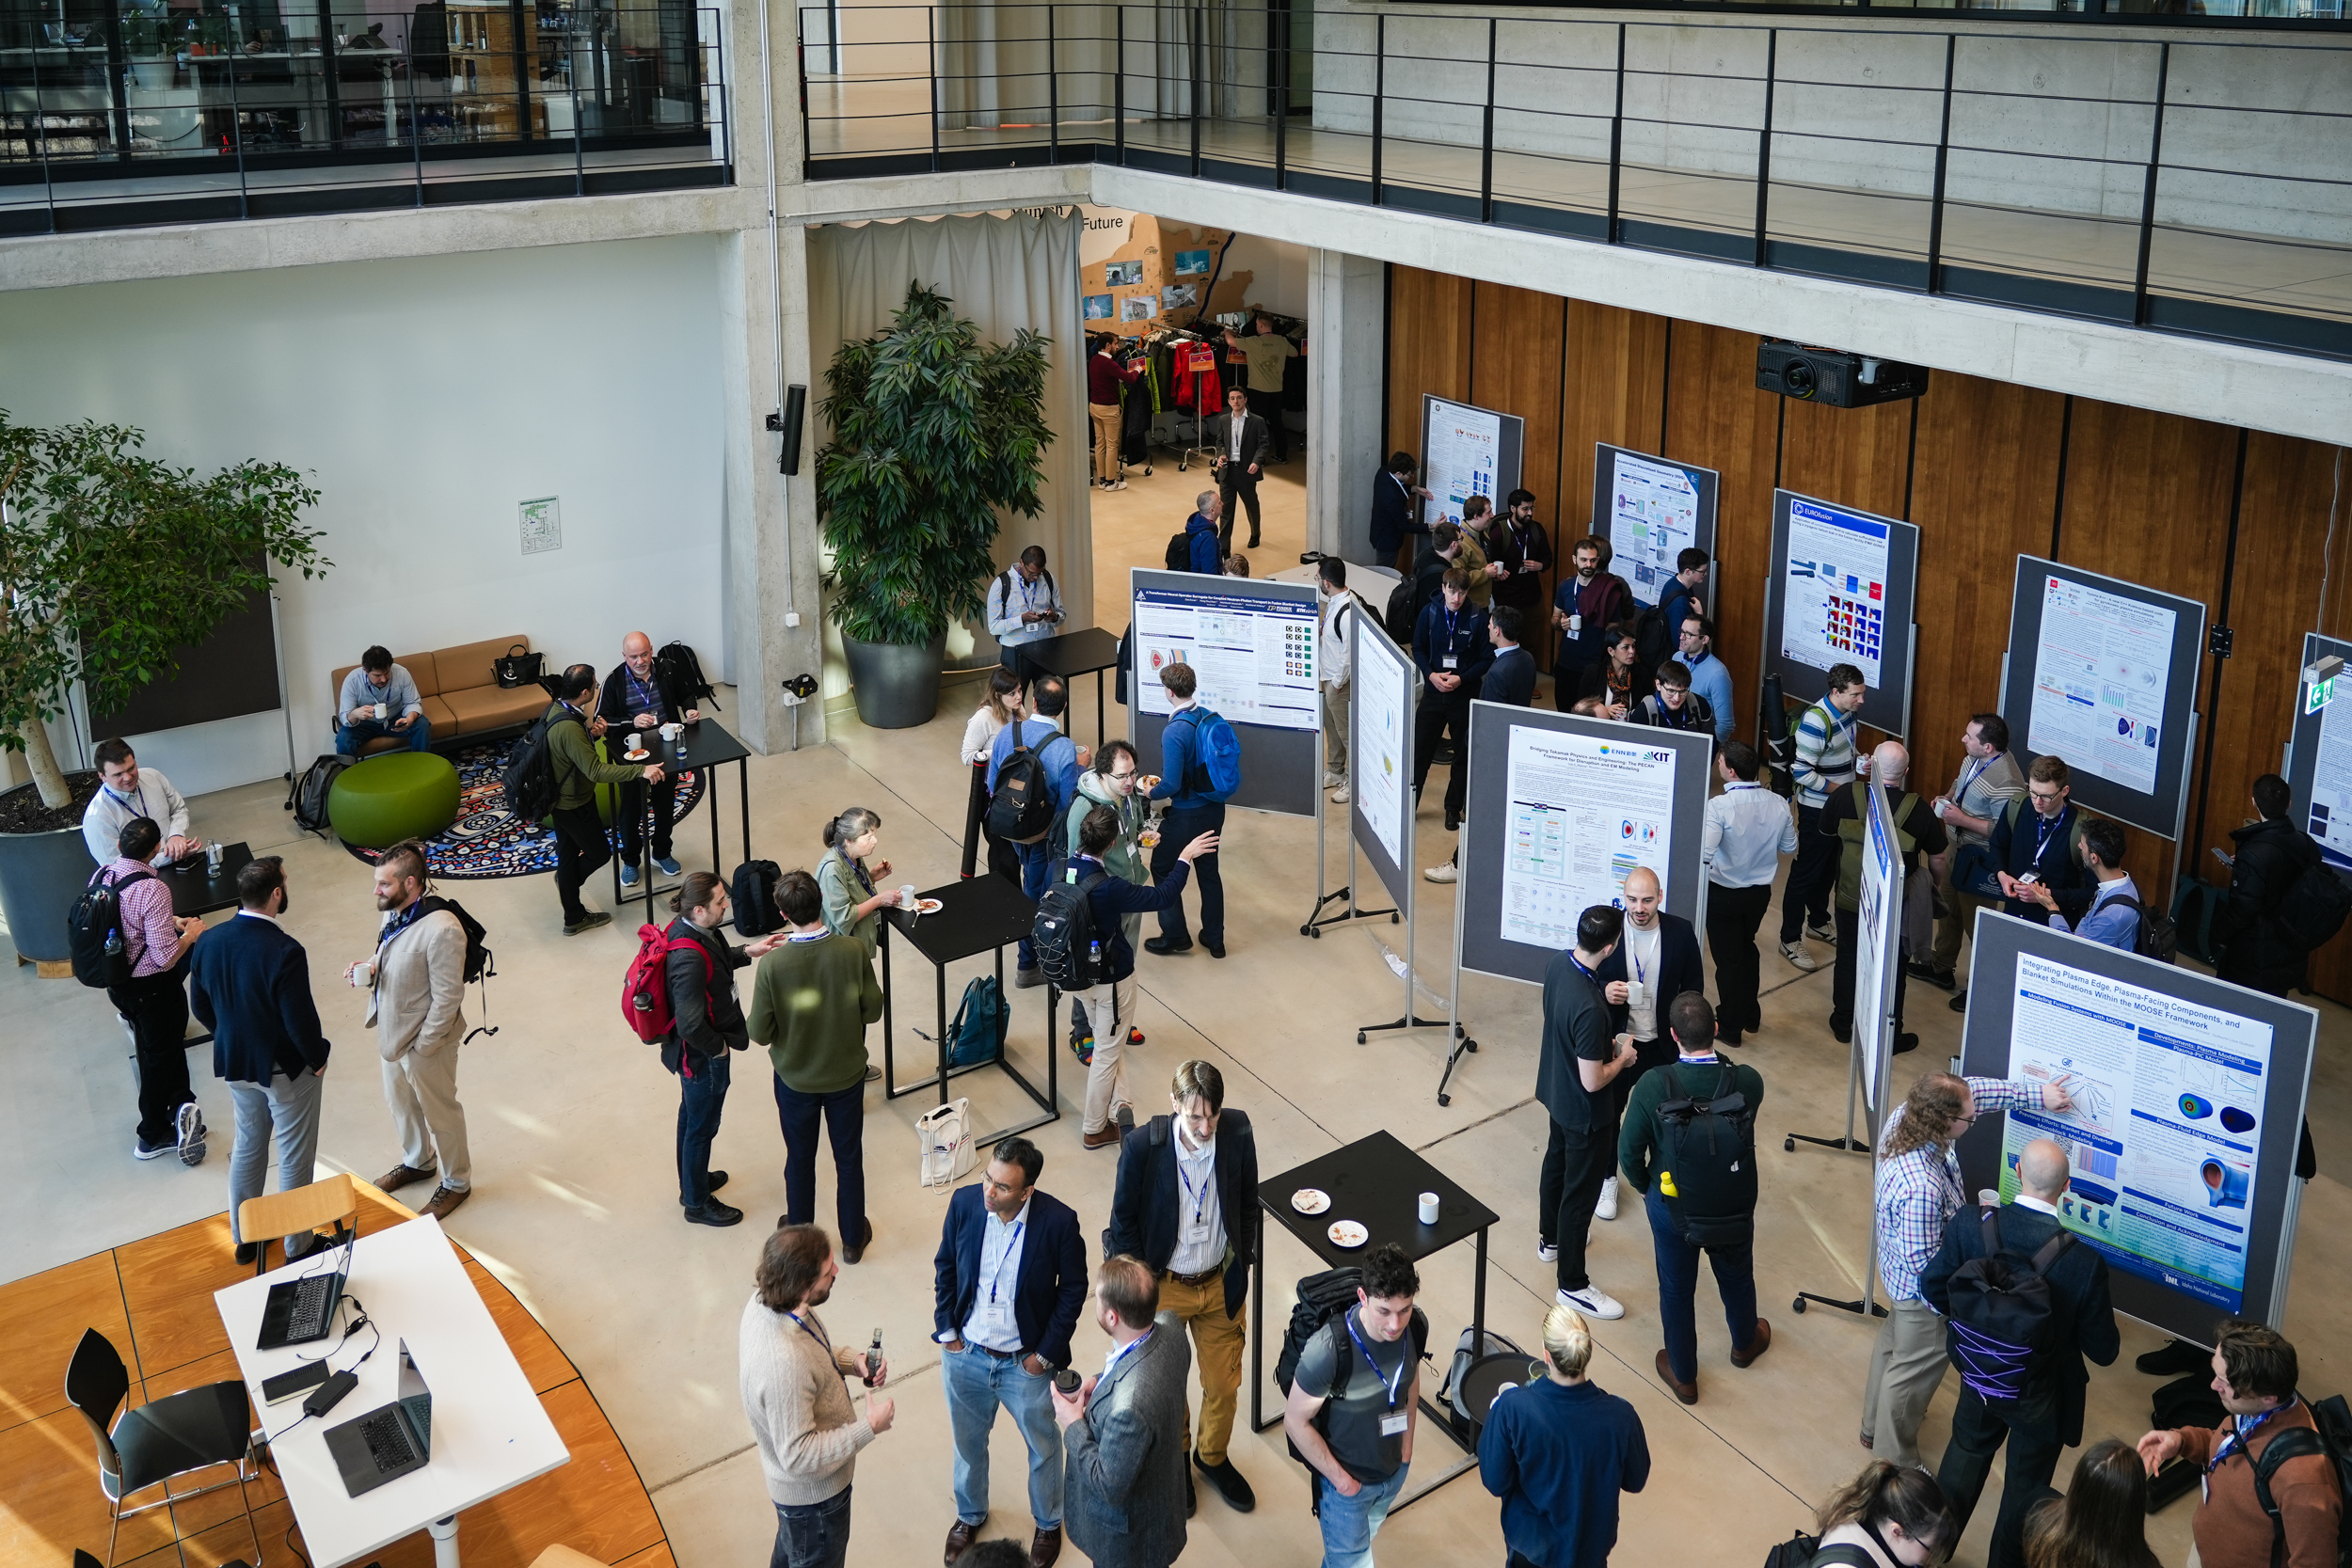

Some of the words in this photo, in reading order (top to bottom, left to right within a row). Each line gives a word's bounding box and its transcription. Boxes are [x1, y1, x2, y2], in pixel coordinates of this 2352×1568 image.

[1083, 217, 1123, 230] Future
[1805, 508, 1833, 521] EUROfusion
[1651, 752, 1670, 762] KIT
[2022, 968, 2048, 982] Blanket
[2051, 977, 2093, 996] Simulations
[2095, 990, 2118, 1003] Within
[2120, 998, 2132, 1007] the
[2134, 1003, 2163, 1017] MOOSE
[2165, 1012, 2208, 1030] Framework
[2023, 958, 2061, 977] Integrating
[2063, 971, 2089, 984] Plasma
[2091, 979, 2112, 992] Edge,
[2114, 986, 2169, 1009] Plasma-Facing
[2171, 1003, 2223, 1025] Components,
[2225, 1020, 2240, 1029] and
[2028, 993, 2052, 1004] Modeling
[2053, 1000, 2070, 1010] Fusion
[2071, 1006, 2092, 1017] Systems
[2093, 1012, 2105, 1021] with
[2106, 1017, 2126, 1028] MOOSE
[2154, 1032, 2196, 1049] Developments:
[2197, 1045, 2217, 1055] Plasma
[2218, 1051, 2246, 1065] Modeling
[2173, 1046, 2204, 1059] Plasma-PIC
[2205, 1055, 2224, 1065] Model
[2019, 1110, 2040, 1121] Previous
[2041, 1117, 2060, 1128] Efforts:
[2061, 1123, 2080, 1134] Blanket
[2092, 1133, 2114, 1145] Divertor
[2037, 1123, 2066, 1137] Monoblock
[2068, 1133, 2093, 1146] Modeling
[2157, 1118, 2192, 1134] Plasma-Fluid
[2192, 1129, 2206, 1139] Edge
[2207, 1135, 2226, 1145] Model
[2165, 1202, 2183, 1212] Future
[2184, 1209, 2199, 1218] Work
[2136, 1212, 2165, 1226] Conclusion
[2177, 1226, 2226, 1248] Acknowledgment
[2165, 1273, 2179, 1286] INL
[2181, 1282, 2193, 1290] Idaho
[2193, 1286, 2209, 1295] National
[2210, 1291, 2230, 1303] Laboratory
